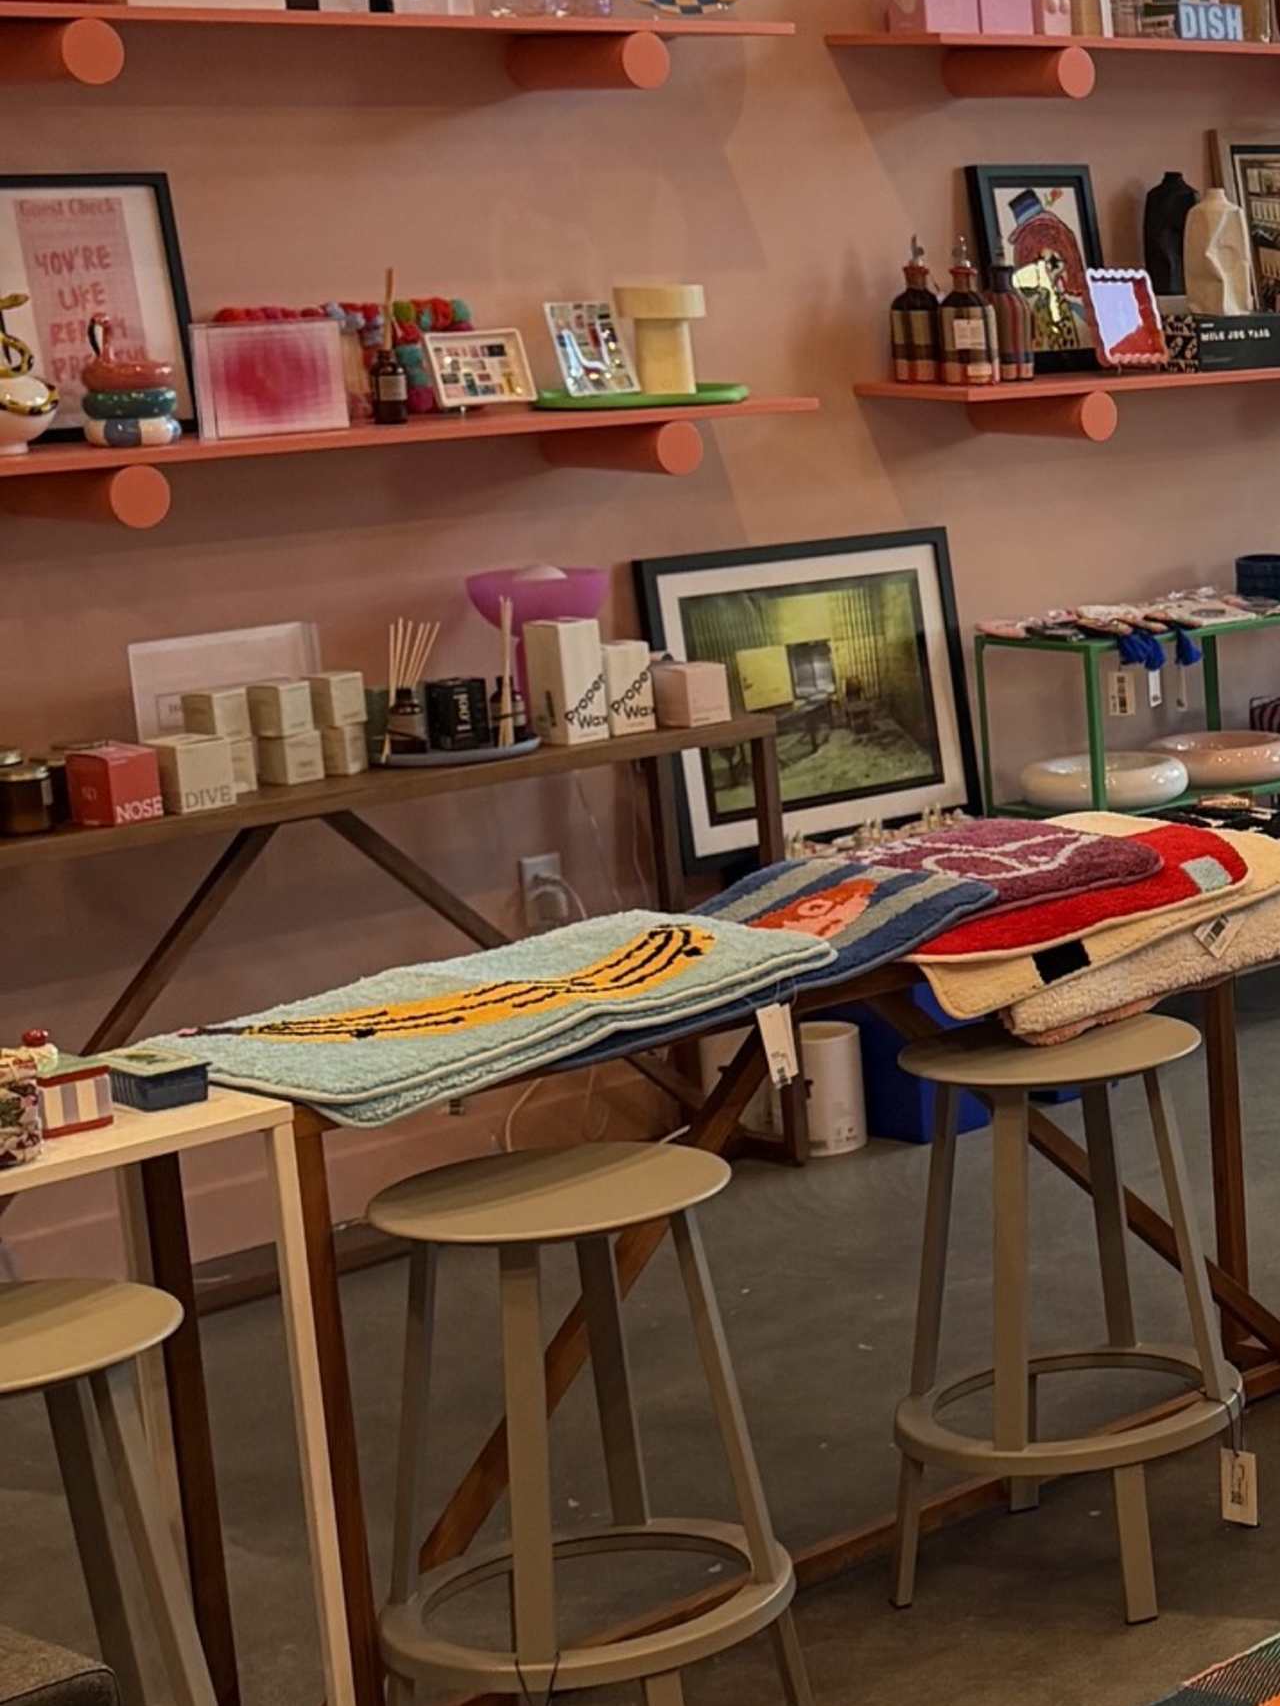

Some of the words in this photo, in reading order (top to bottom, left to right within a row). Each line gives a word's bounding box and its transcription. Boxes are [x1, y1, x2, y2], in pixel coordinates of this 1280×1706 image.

[1180, 4, 1243, 41] DISH
[577, 714, 609, 730] Wax
[114, 795, 163, 824] NOSE
[183, 784, 233, 809] DIVE
